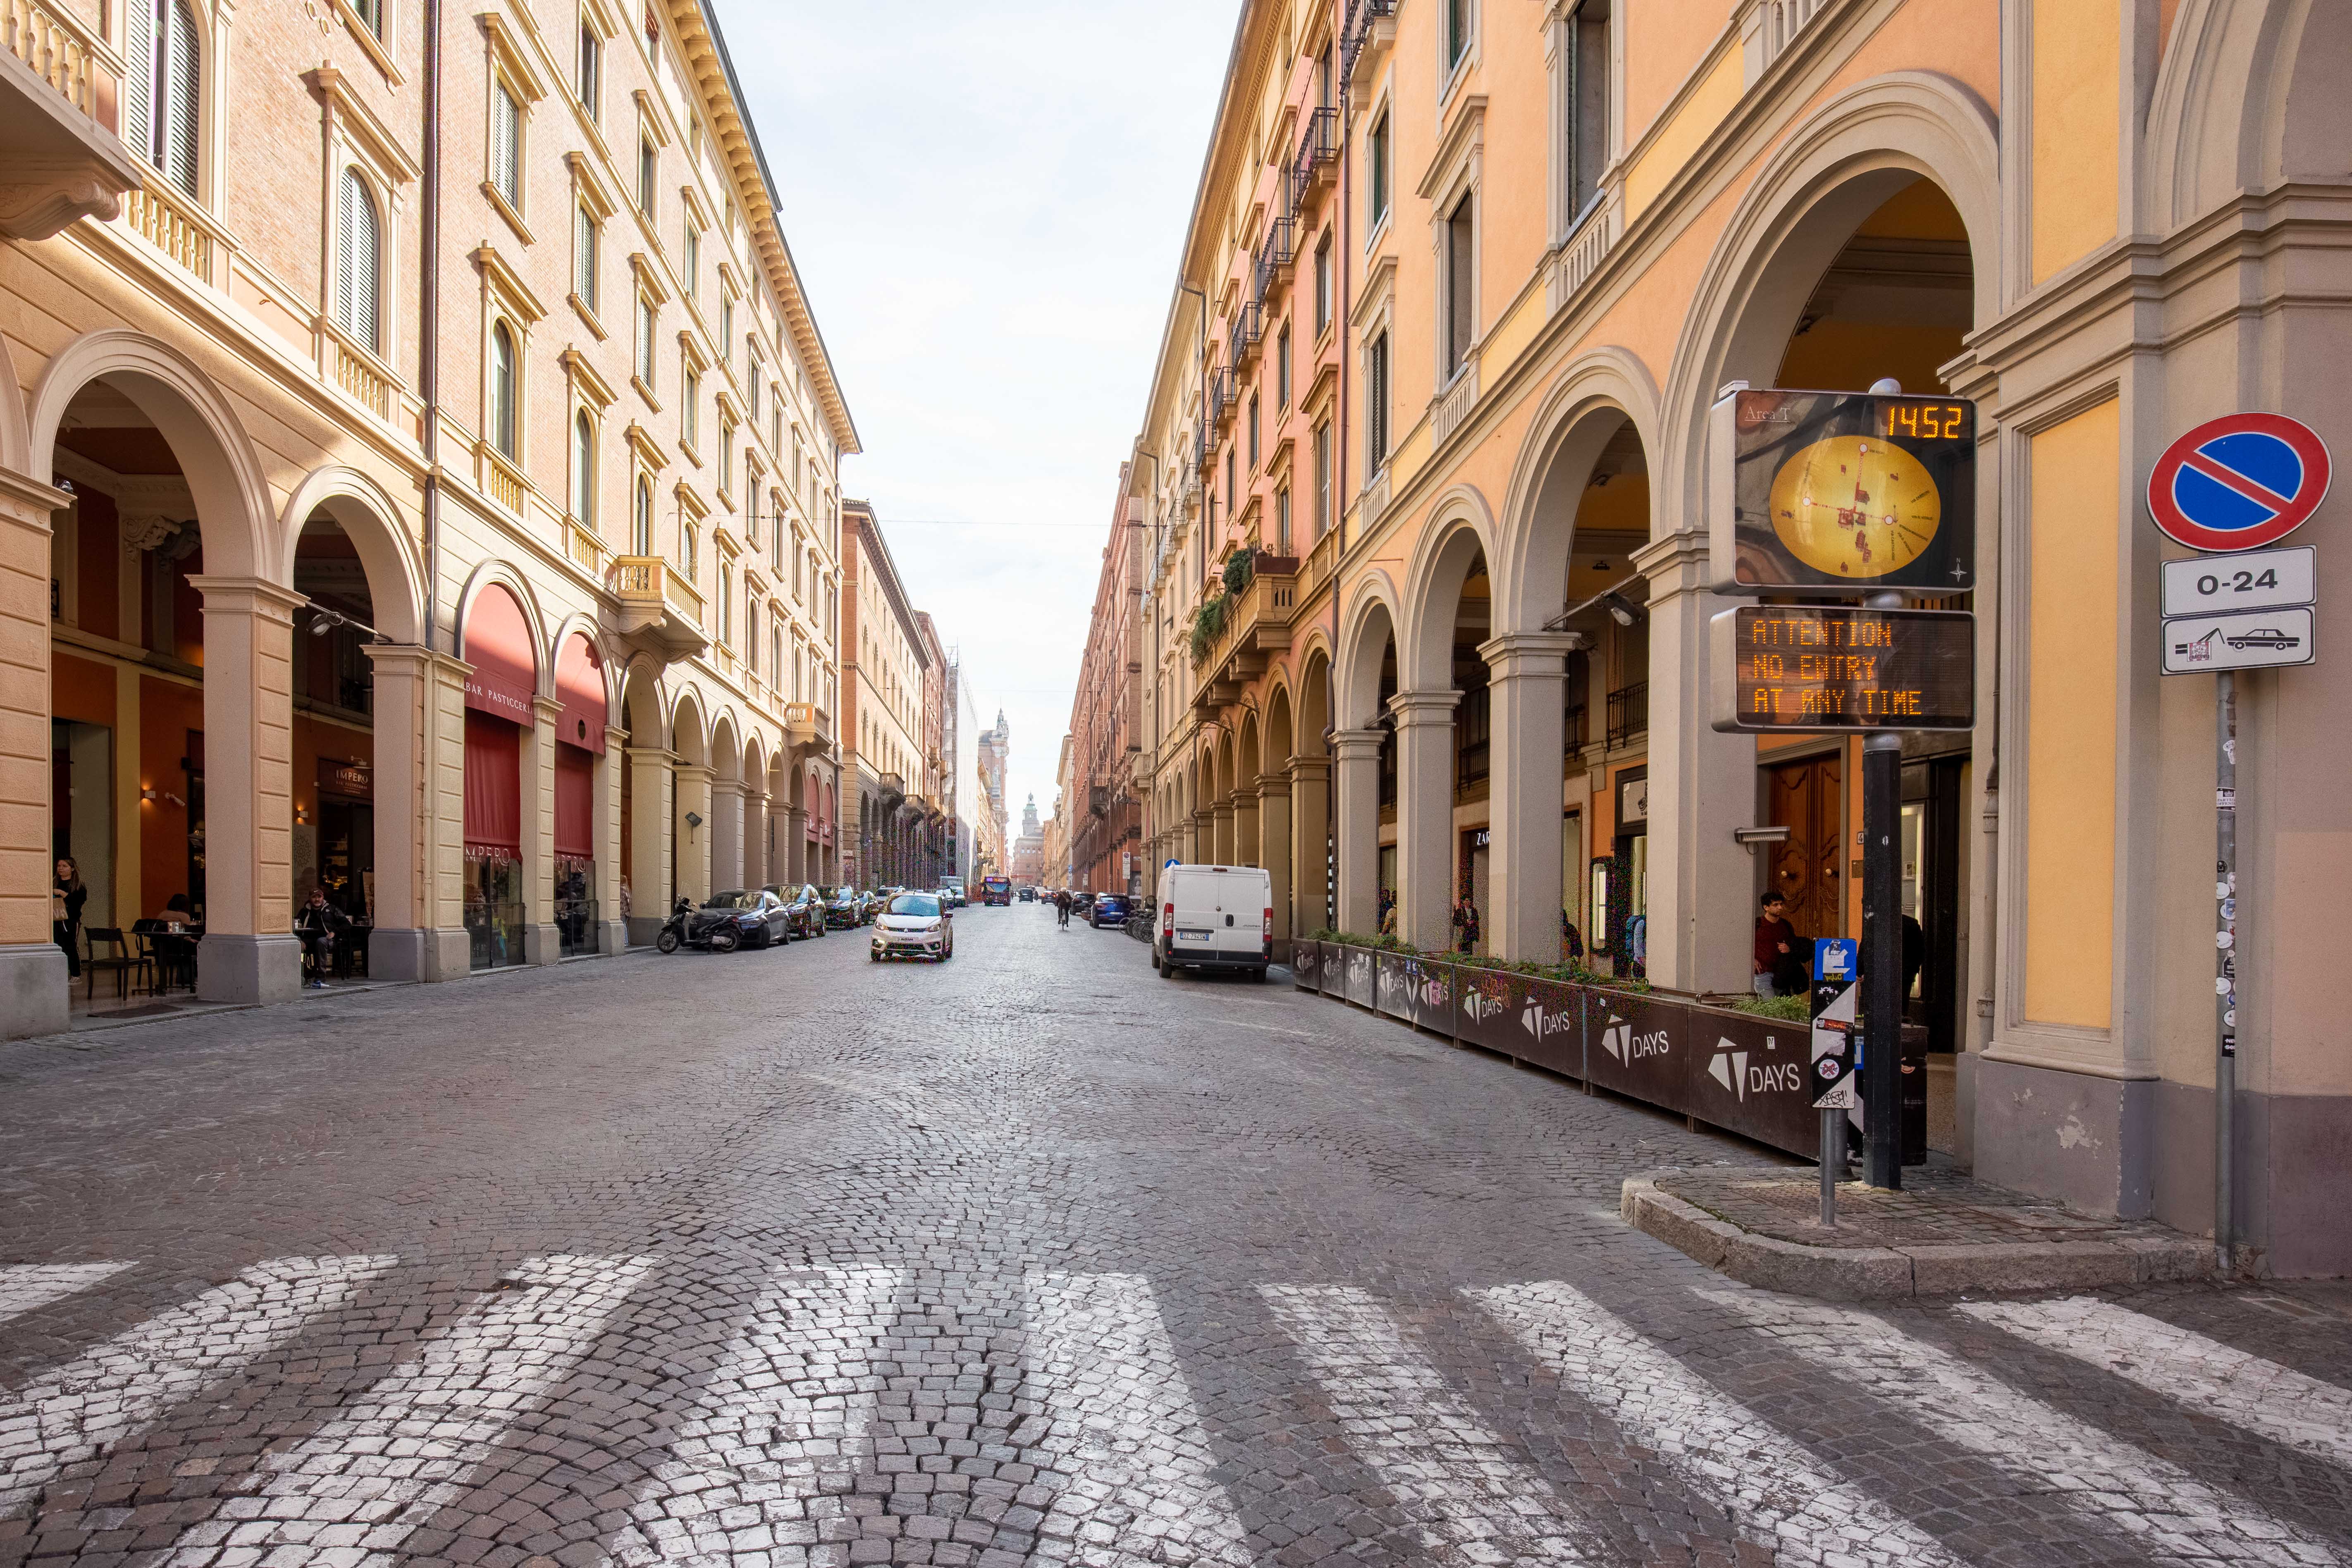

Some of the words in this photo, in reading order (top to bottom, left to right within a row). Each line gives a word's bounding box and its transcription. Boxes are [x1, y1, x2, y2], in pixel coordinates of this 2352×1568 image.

[1746, 406, 1775, 419] Area
[1780, 407, 1791, 420] T
[2197, 568, 2278, 595] 0-24
[1753, 620, 1891, 647] ATTENTION
[1754, 654, 1784, 679] NO
[1800, 655, 1877, 680] ENTRY
[466, 682, 483, 696] BAR
[1754, 689, 1784, 713] AT
[1801, 689, 1846, 714] ANY
[1863, 690, 1922, 715] TIME
[336, 770, 368, 784] IMPERO
[1477, 831, 1490, 845] ZAR
[466, 846, 511, 866] MPERO
[1390, 974, 1404, 992] DAYS
[1481, 996, 1503, 1017] DAYS
[1543, 1011, 1570, 1034] DAYS
[1633, 1030, 1669, 1058] DAYS
[1750, 1063, 1800, 1092] DAYS
